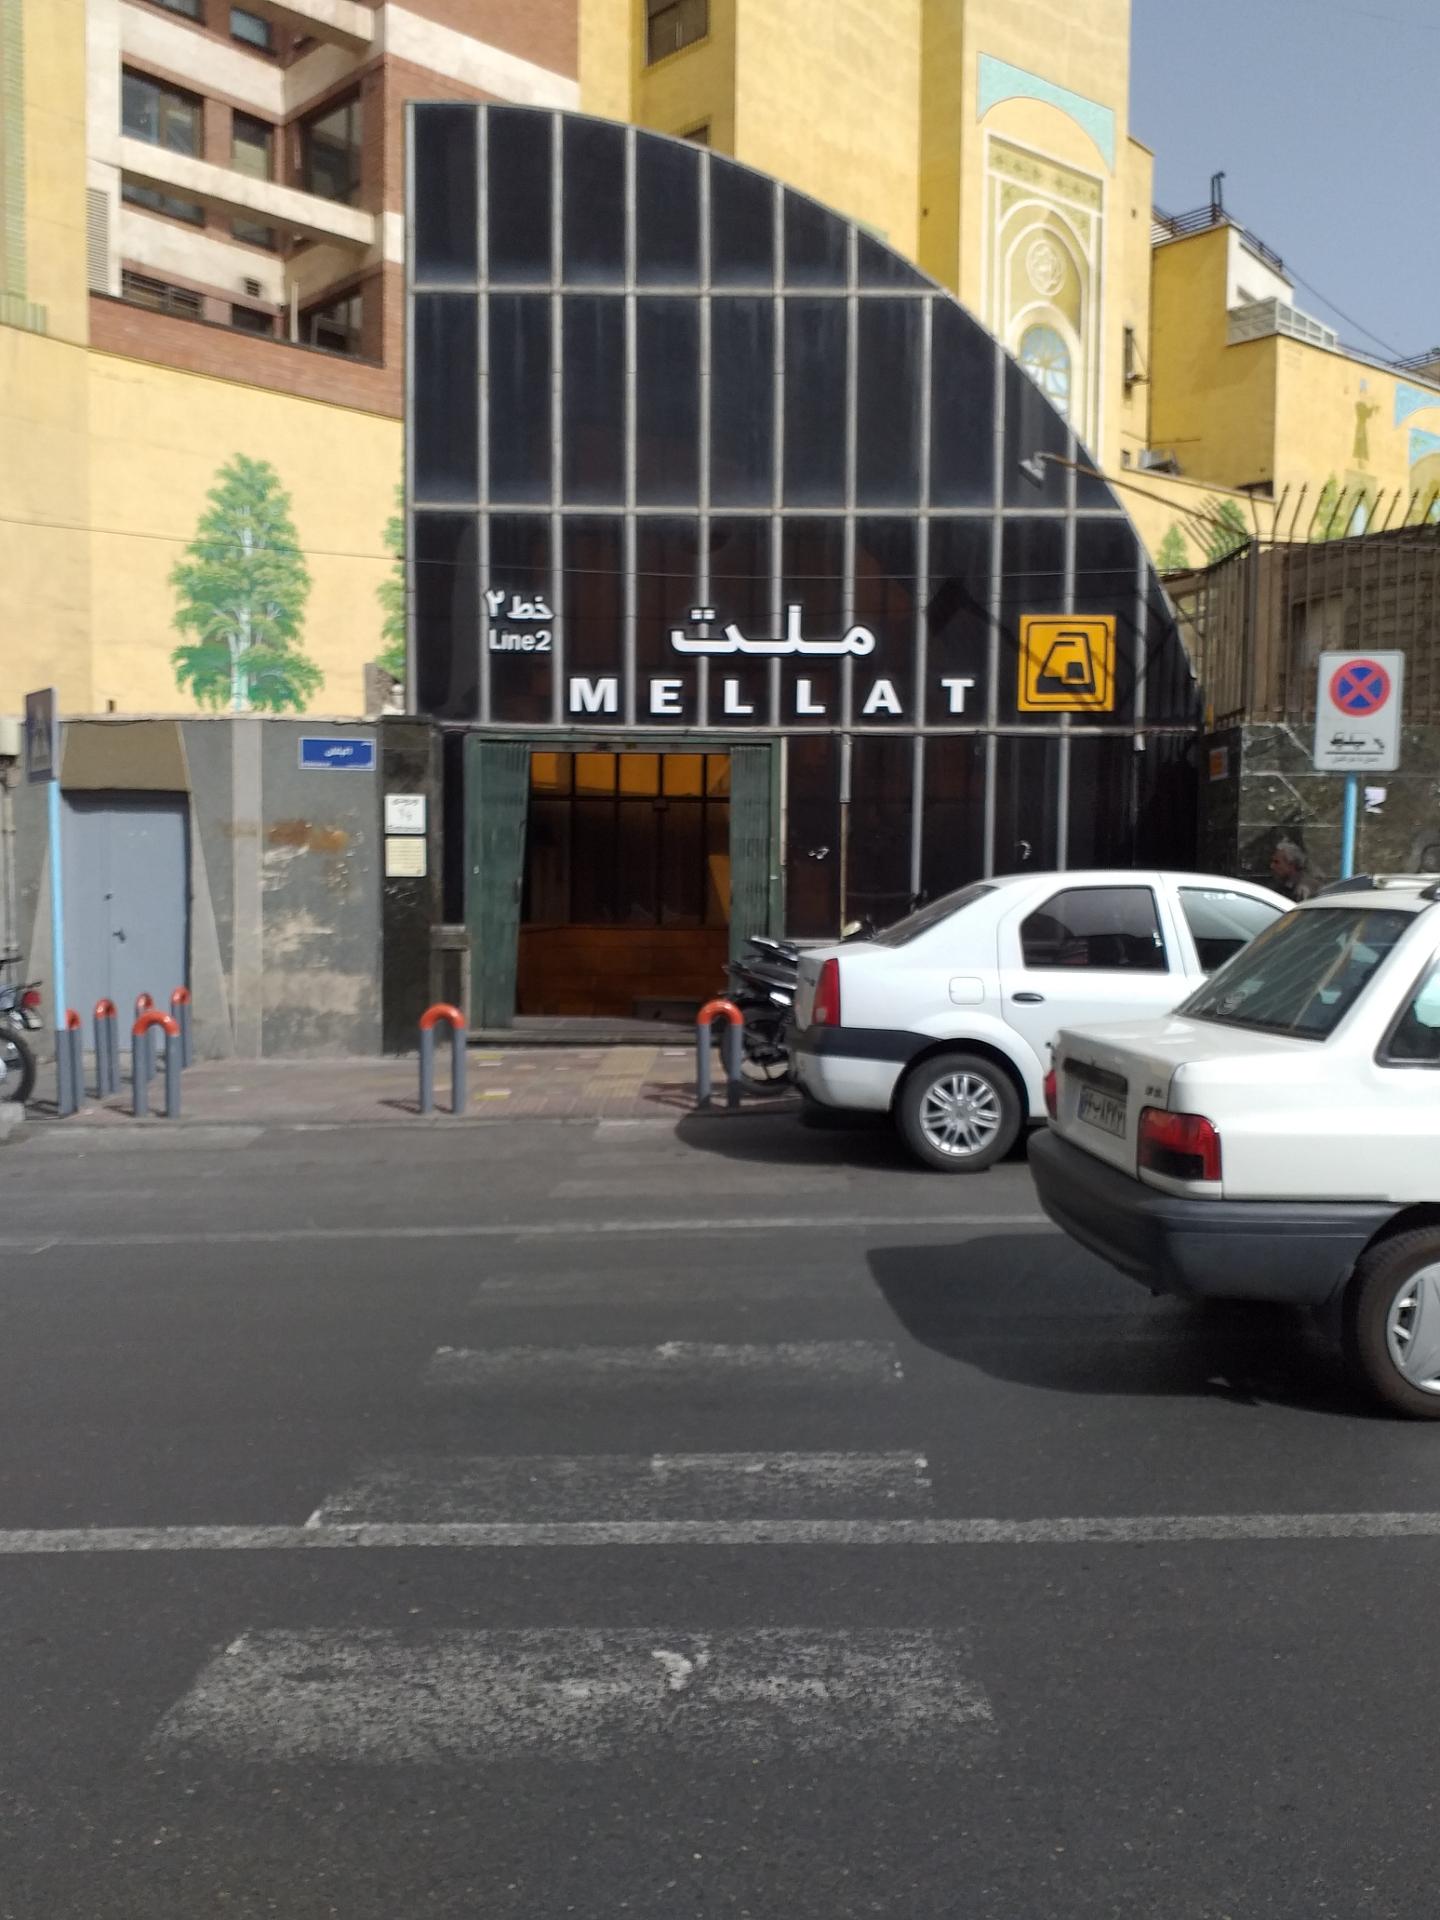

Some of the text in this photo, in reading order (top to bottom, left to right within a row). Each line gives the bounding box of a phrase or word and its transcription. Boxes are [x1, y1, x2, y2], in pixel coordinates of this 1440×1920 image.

[507, 595, 554, 619] خط
[670, 604, 876, 656] ملت
[569, 677, 975, 714] MELLAT
